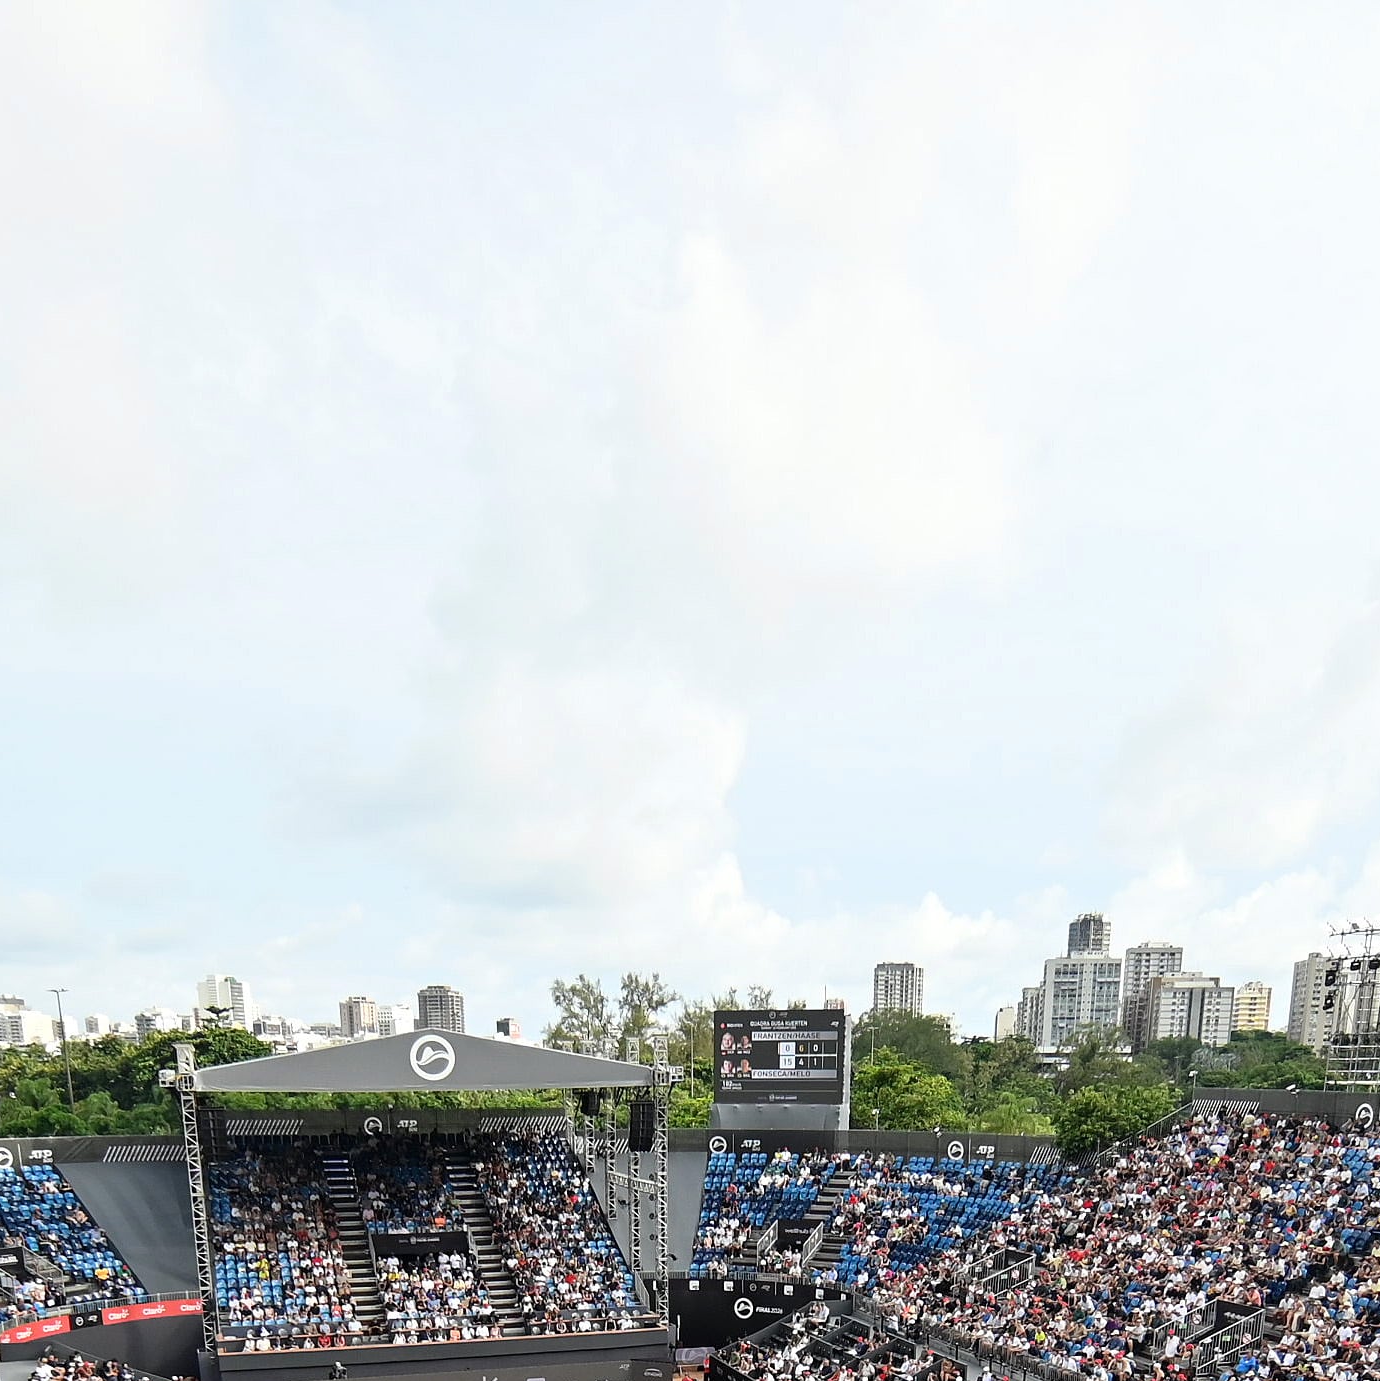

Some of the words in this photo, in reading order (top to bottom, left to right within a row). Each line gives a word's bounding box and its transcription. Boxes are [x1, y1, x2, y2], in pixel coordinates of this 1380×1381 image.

[397, 1119, 418, 1128] ATP
[740, 1139, 761, 1148] ATP
[755, 1306, 771, 1314] FINAL
